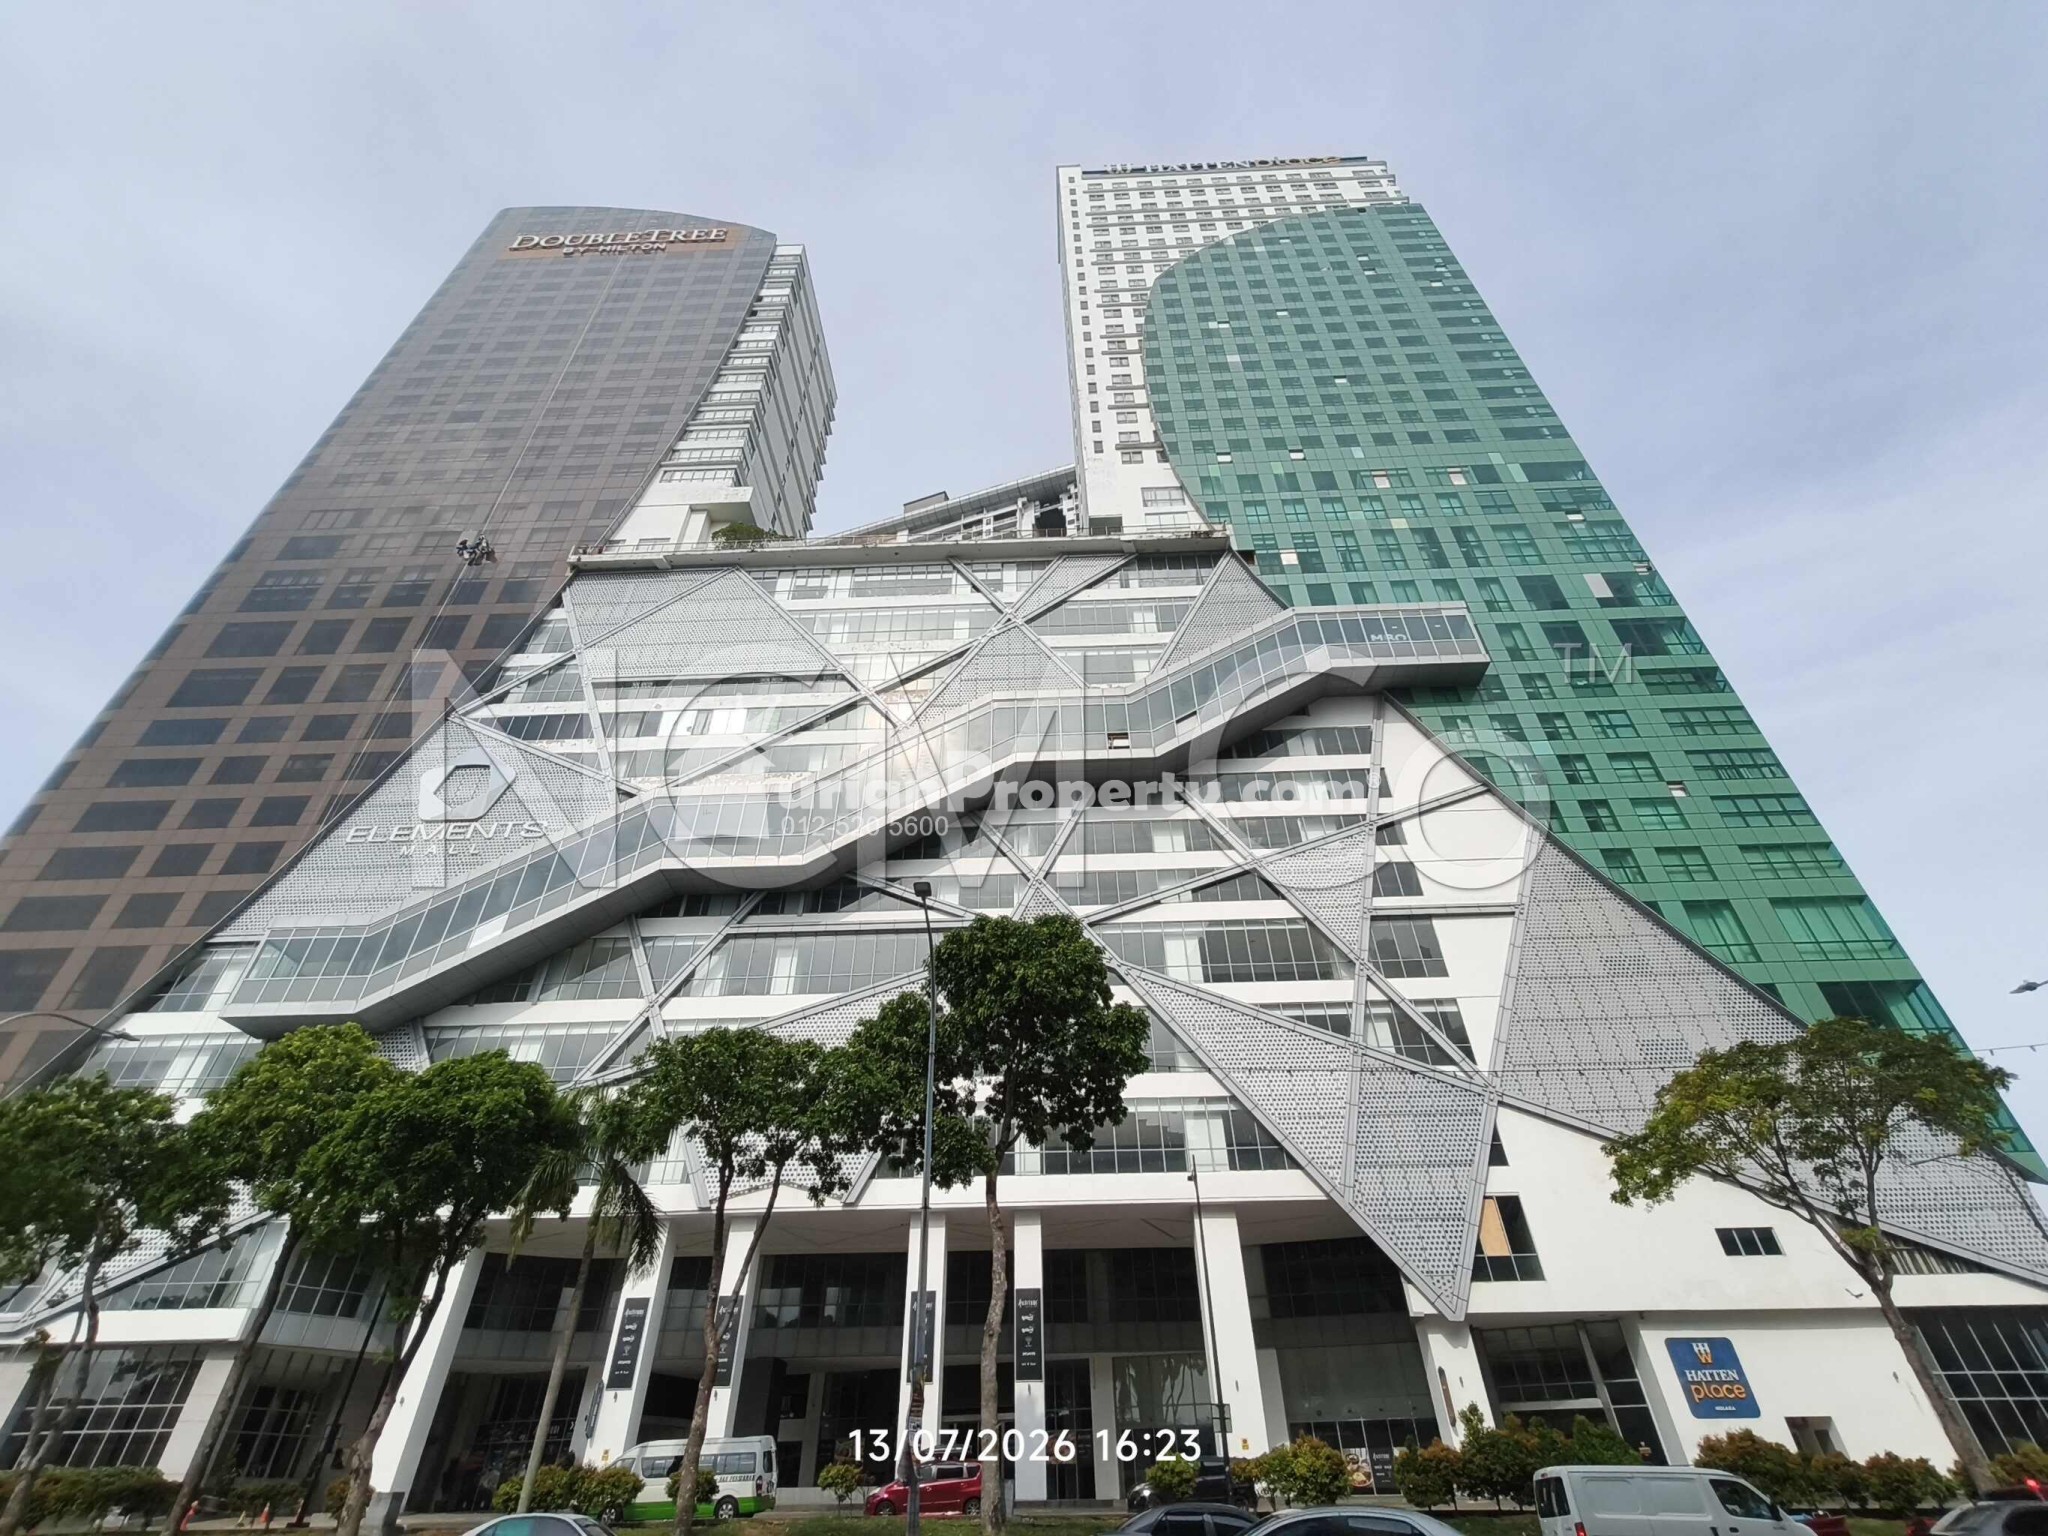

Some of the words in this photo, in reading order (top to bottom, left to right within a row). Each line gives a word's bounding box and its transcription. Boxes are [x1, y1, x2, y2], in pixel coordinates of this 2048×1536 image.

[598, 242, 667, 253] HILTON
[345, 820, 548, 844] ELEMENTS
[399, 843, 483, 858] MALL
[1684, 1369, 1740, 1382] HATTEN
[1690, 1381, 1747, 1403] place
